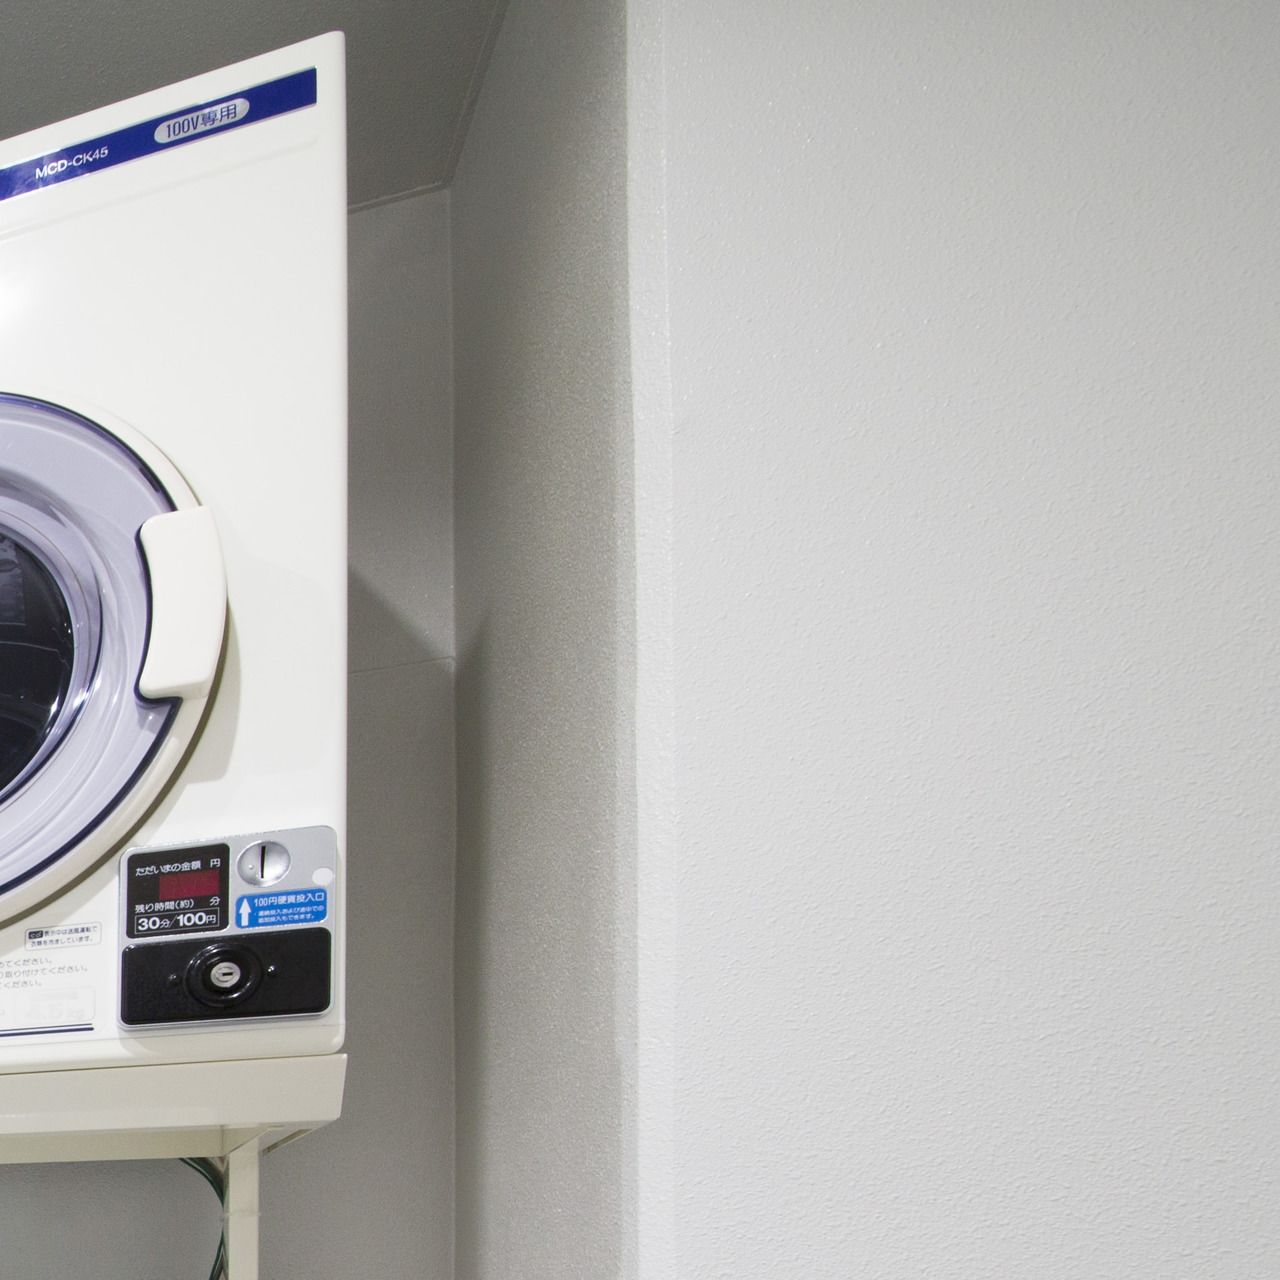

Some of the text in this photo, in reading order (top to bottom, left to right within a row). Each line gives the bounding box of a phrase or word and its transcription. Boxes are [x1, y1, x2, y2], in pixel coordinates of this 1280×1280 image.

[34, 146, 109, 180] MCD-CK45
[210, 858, 221, 868] 円
[210, 897, 220, 906] 分
